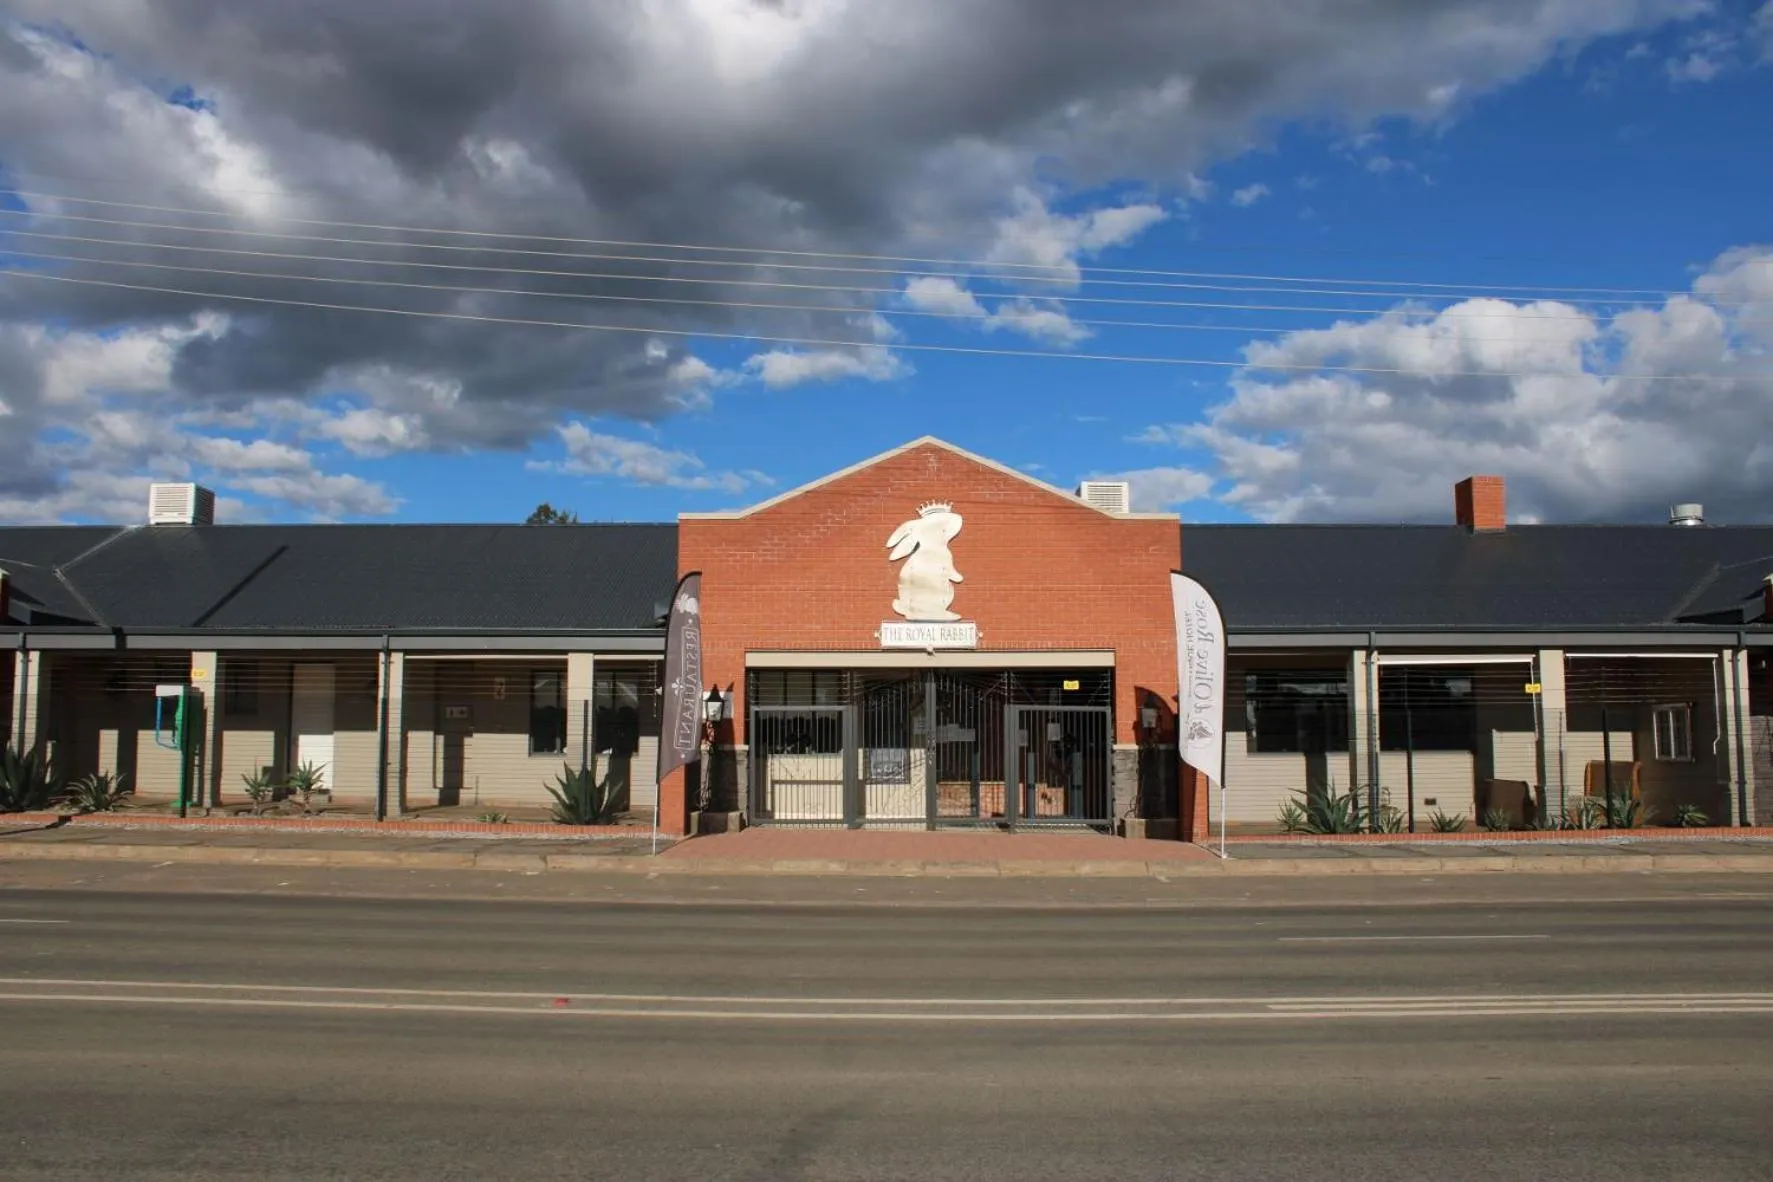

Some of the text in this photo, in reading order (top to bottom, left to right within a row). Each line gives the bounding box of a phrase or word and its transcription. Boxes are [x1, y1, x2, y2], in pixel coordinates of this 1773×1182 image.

[883, 626, 974, 642] THE ROYAL RABBIT
